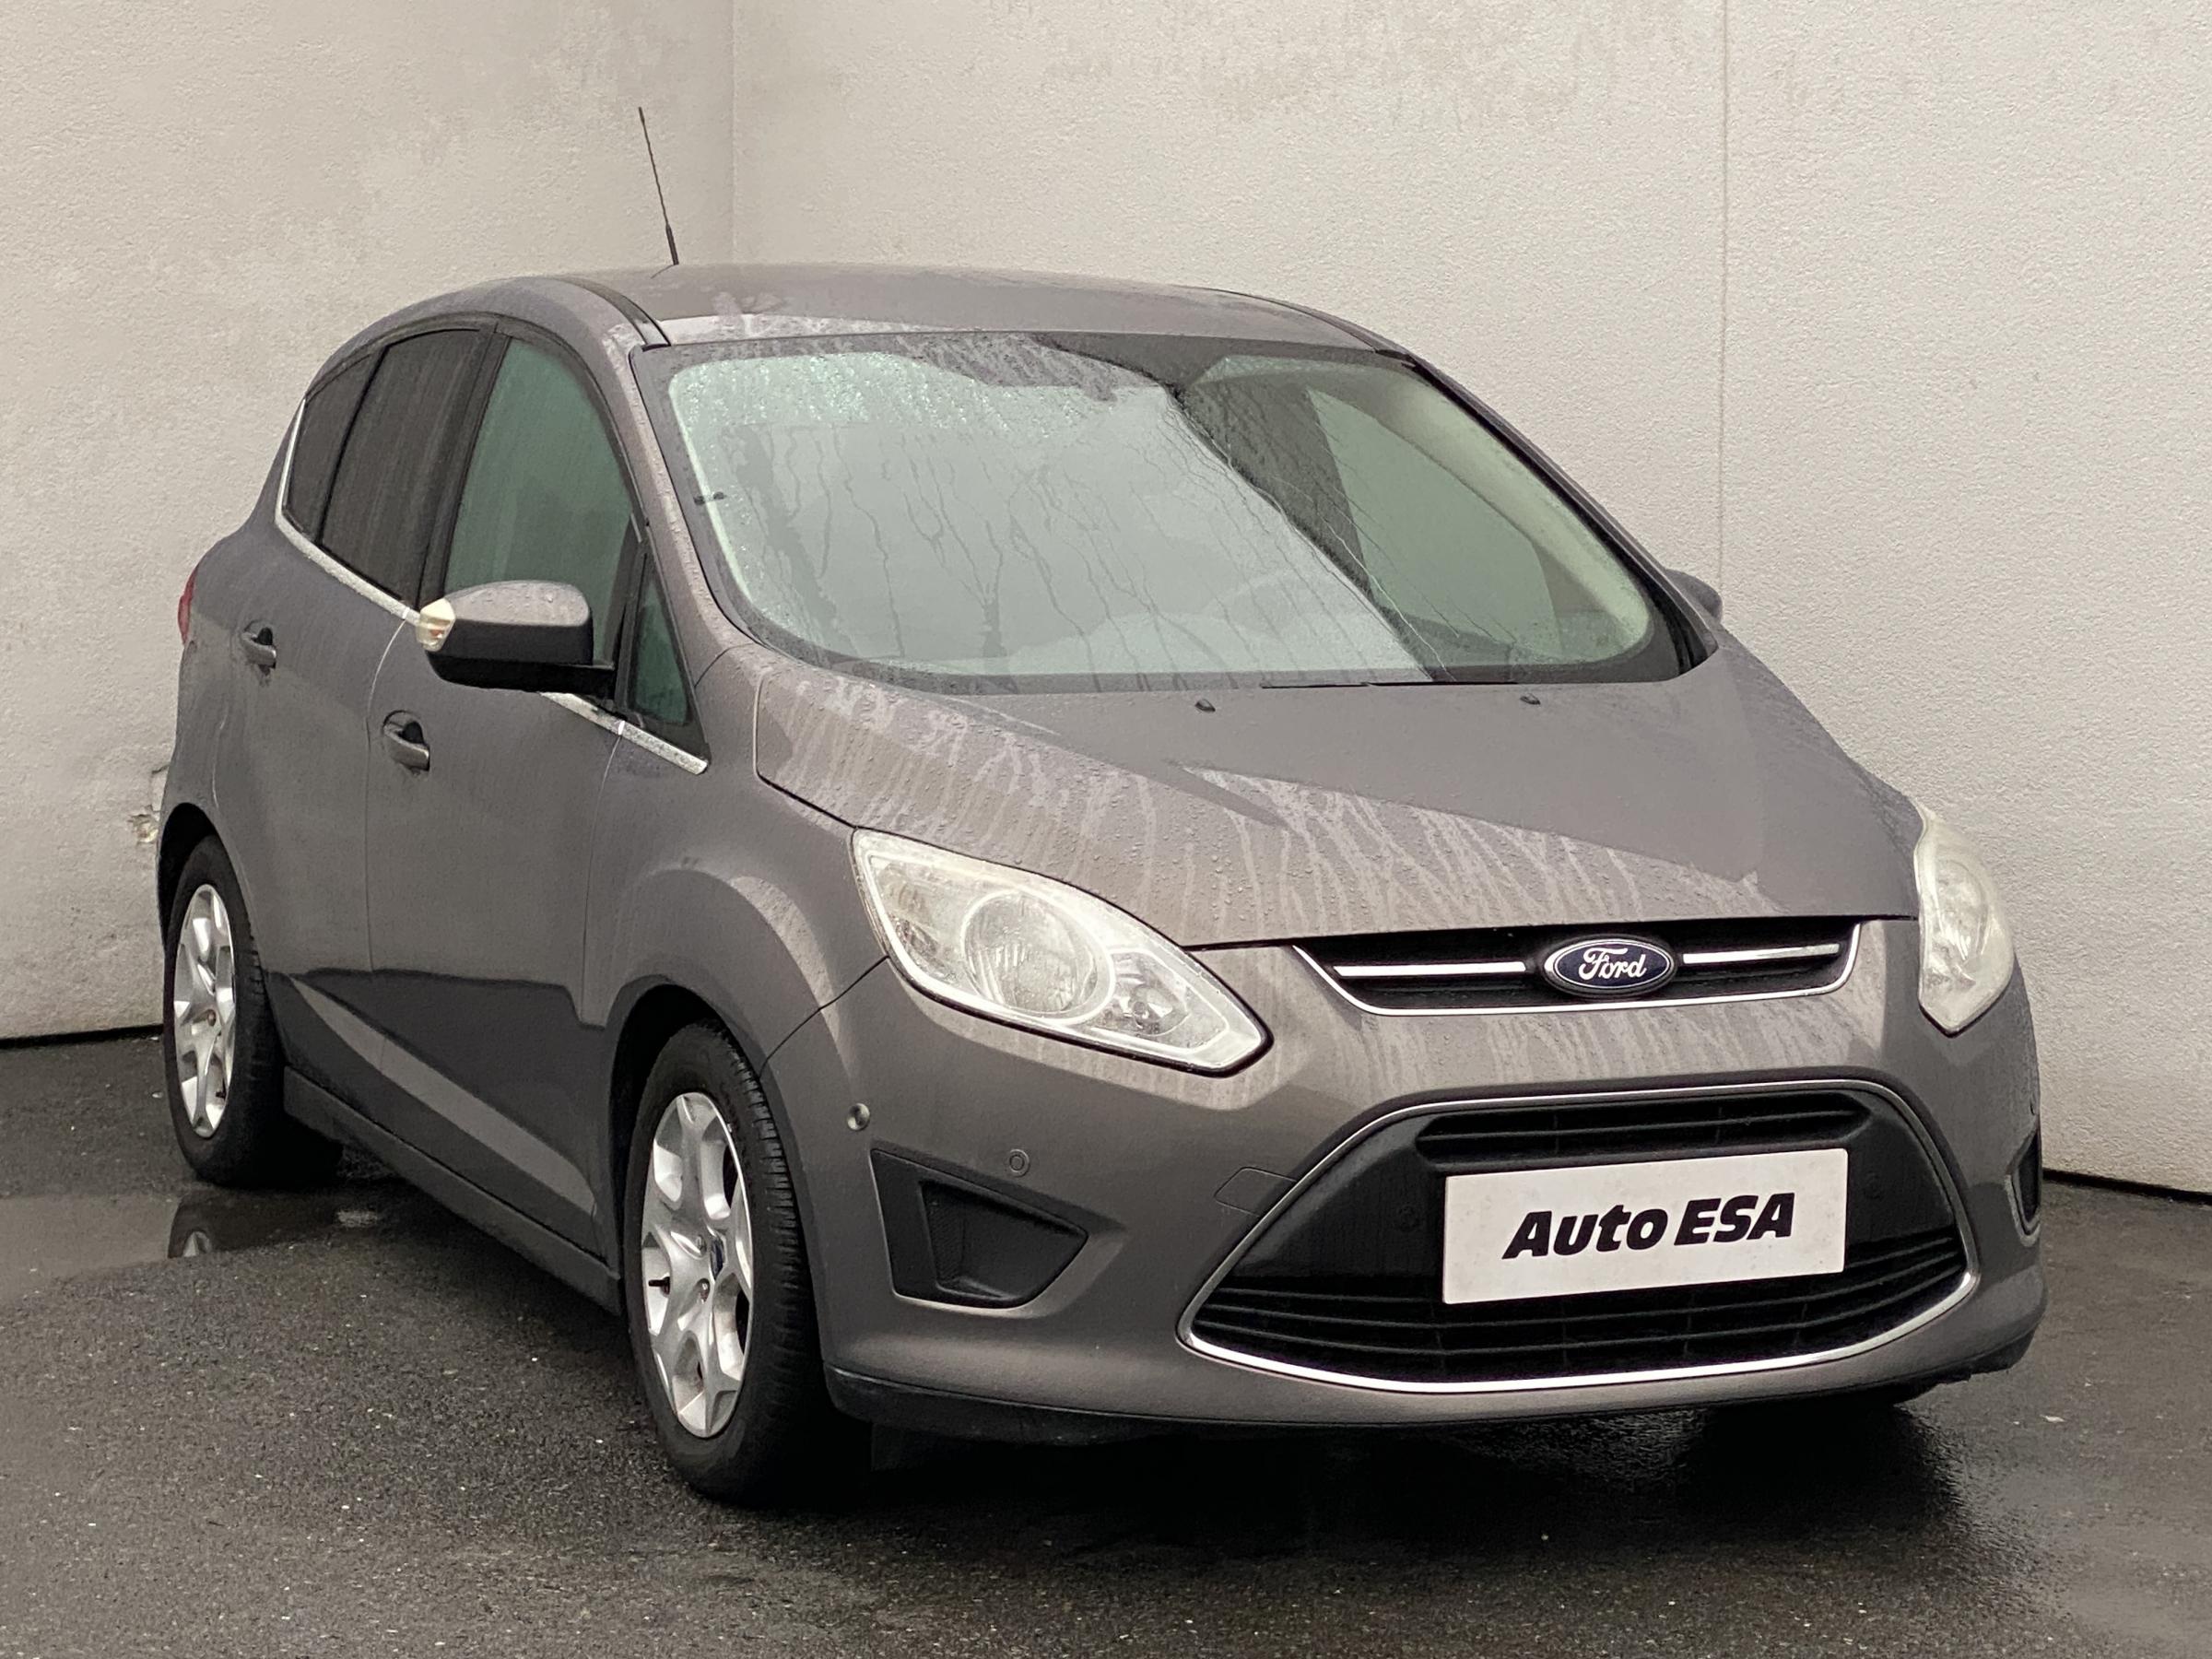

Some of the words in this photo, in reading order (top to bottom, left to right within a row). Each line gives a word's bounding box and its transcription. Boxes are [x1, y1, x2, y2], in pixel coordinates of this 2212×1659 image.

[1578, 947, 1647, 981] Ford
[1501, 1205, 1668, 1259] Auto
[1673, 1193, 1794, 1245] ESA
